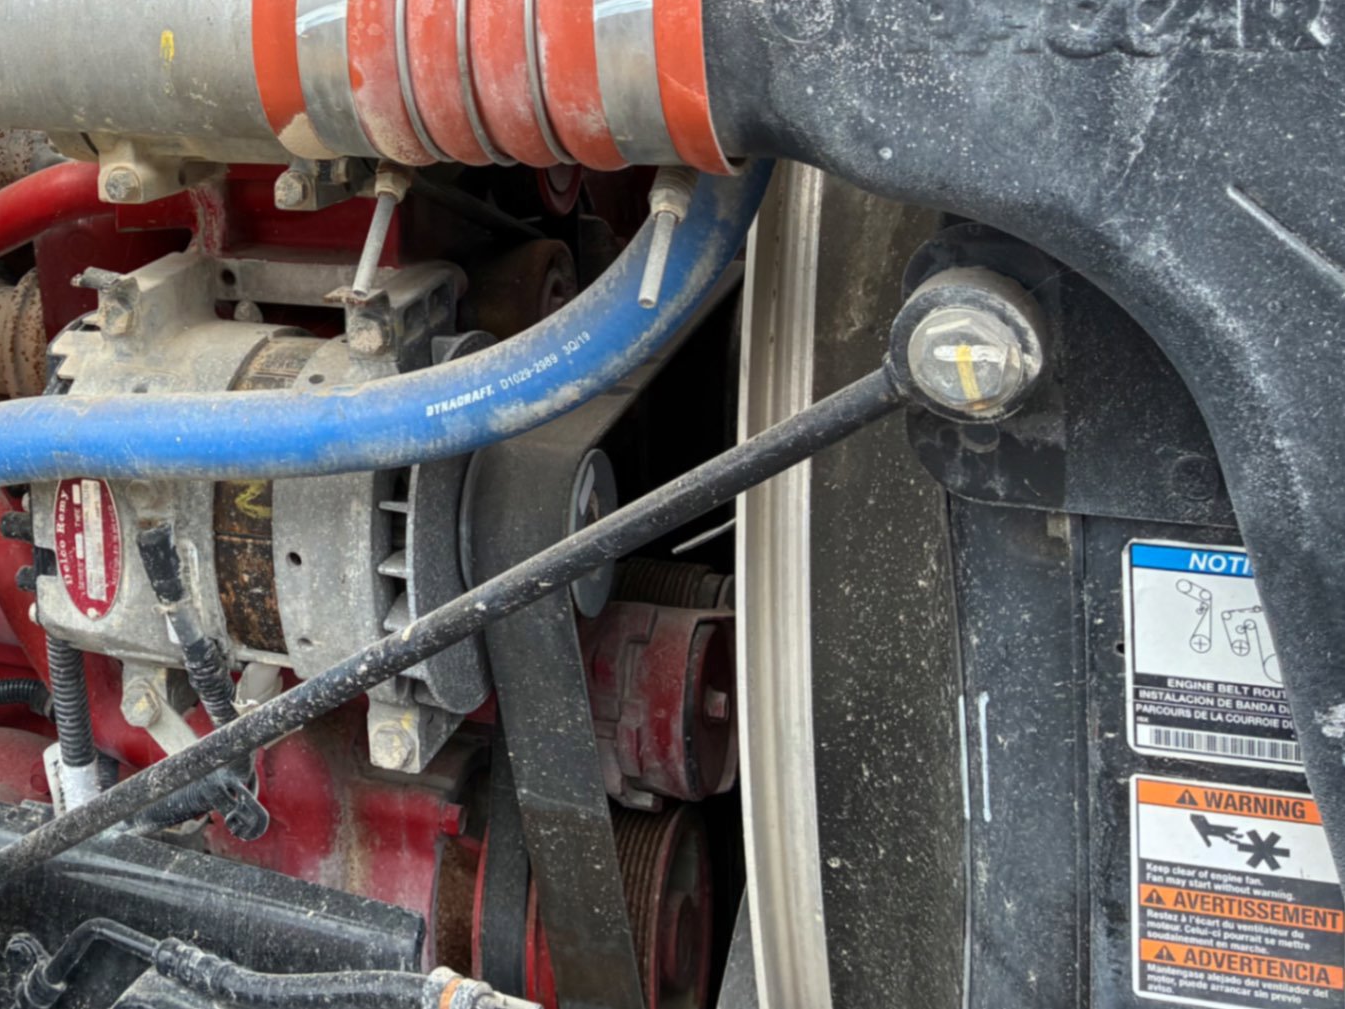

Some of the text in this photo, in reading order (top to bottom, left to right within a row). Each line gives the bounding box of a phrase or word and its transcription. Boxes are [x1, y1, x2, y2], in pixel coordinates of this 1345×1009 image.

[56, 489, 73, 585] Delco Remy
[1188, 552, 1252, 576] NOTI
[1139, 689, 1215, 707] INSTALACION
[1217, 698, 1232, 709] DE
[1235, 700, 1276, 714] BANDA
[1166, 678, 1287, 700] ENGINE BELT ROUT
[1135, 703, 1192, 719] PARCOURS
[1194, 710, 1208, 721] DE
[1210, 711, 1224, 722] LA
[1225, 713, 1280, 729] COURROIE
[1204, 791, 1306, 819] WARNING
[1146, 862, 1264, 887] Keep clear of engine fan.
[1146, 873, 1297, 902] Fan may start without warning.
[1146, 909, 1179, 922] Restez
[1223, 920, 1235, 930] du
[1237, 922, 1289, 938] ventilateur
[1291, 929, 1305, 940] du
[1173, 891, 1341, 930] AVERTISSEMENT
[1146, 921, 1311, 952] moteur. Celui-ci pourrait se mettre
[1146, 930, 1270, 955] soudainement en marche.
[1183, 948, 1331, 985] ADVERTENCIA
[1146, 974, 1302, 1005] motor, puede arrancar sin previo
[1207, 972, 1242, 988] alejado
[1244, 977, 1260, 988] del
[1261, 979, 1310, 996] ventilador
[1312, 988, 1329, 999] del
